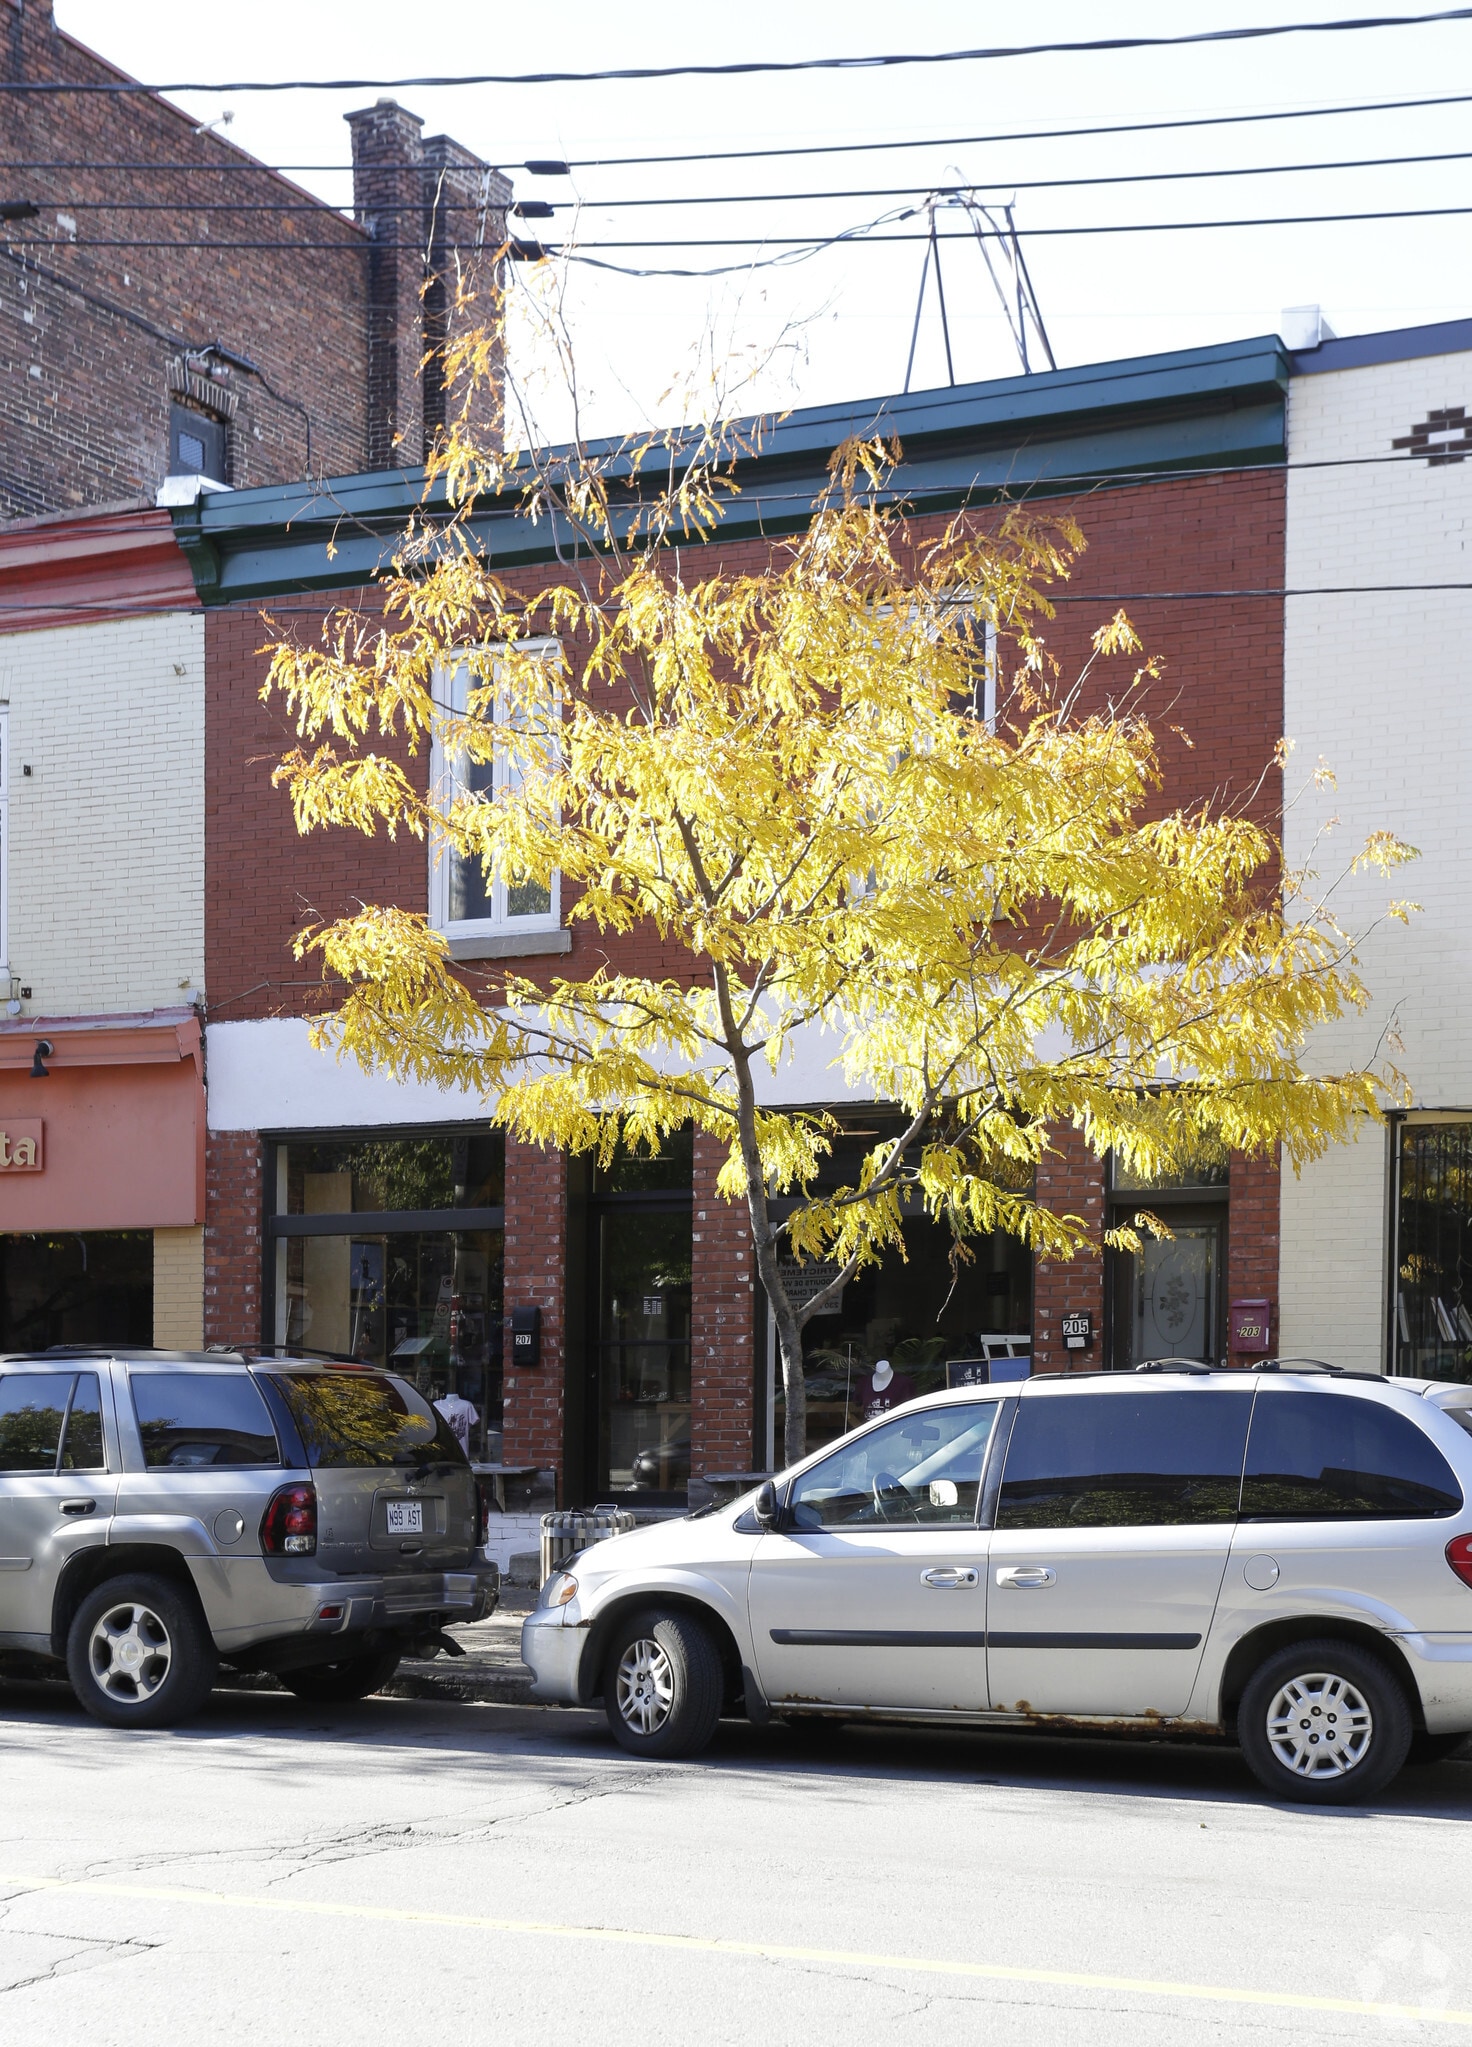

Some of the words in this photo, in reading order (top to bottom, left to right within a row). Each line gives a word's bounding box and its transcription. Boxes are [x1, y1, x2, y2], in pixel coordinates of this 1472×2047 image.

[1064, 1320, 1088, 1334] 205
[1241, 1327, 1260, 1337] 203
[516, 1336, 530, 1344] 207
[389, 1510, 403, 1526] N99
[407, 1509, 421, 1526] AST
